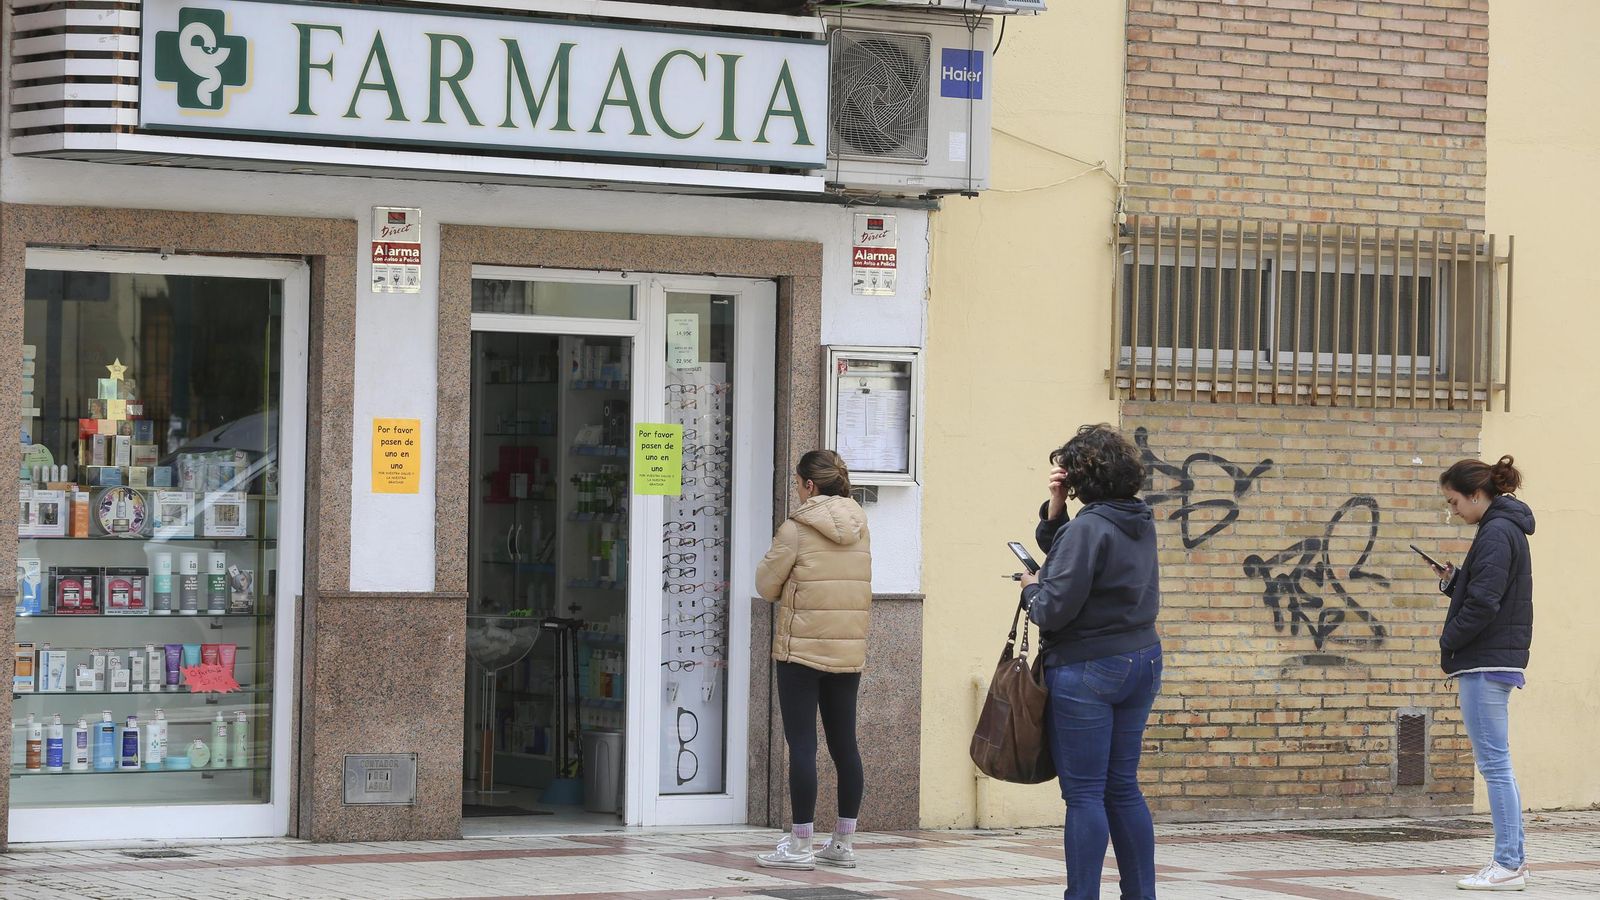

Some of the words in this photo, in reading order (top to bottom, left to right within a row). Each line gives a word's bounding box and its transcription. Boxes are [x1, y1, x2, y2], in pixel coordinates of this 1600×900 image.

[942, 66, 982, 83] Haier
[289, 22, 815, 147] FARMACIA
[381, 224, 413, 238] Direct
[860, 230, 890, 243] Direct
[374, 245, 420, 257] Alarma
[855, 250, 896, 261] Alarma
[377, 425, 391, 434] Por
[393, 425, 413, 434] favor
[654, 430, 674, 438] favor
[380, 439, 402, 447] pasen
[404, 438, 414, 446] de
[641, 443, 662, 451] pasen
[664, 442, 674, 450] de
[360, 759, 399, 768] CONTADOR
[373, 771, 384, 780] DE
